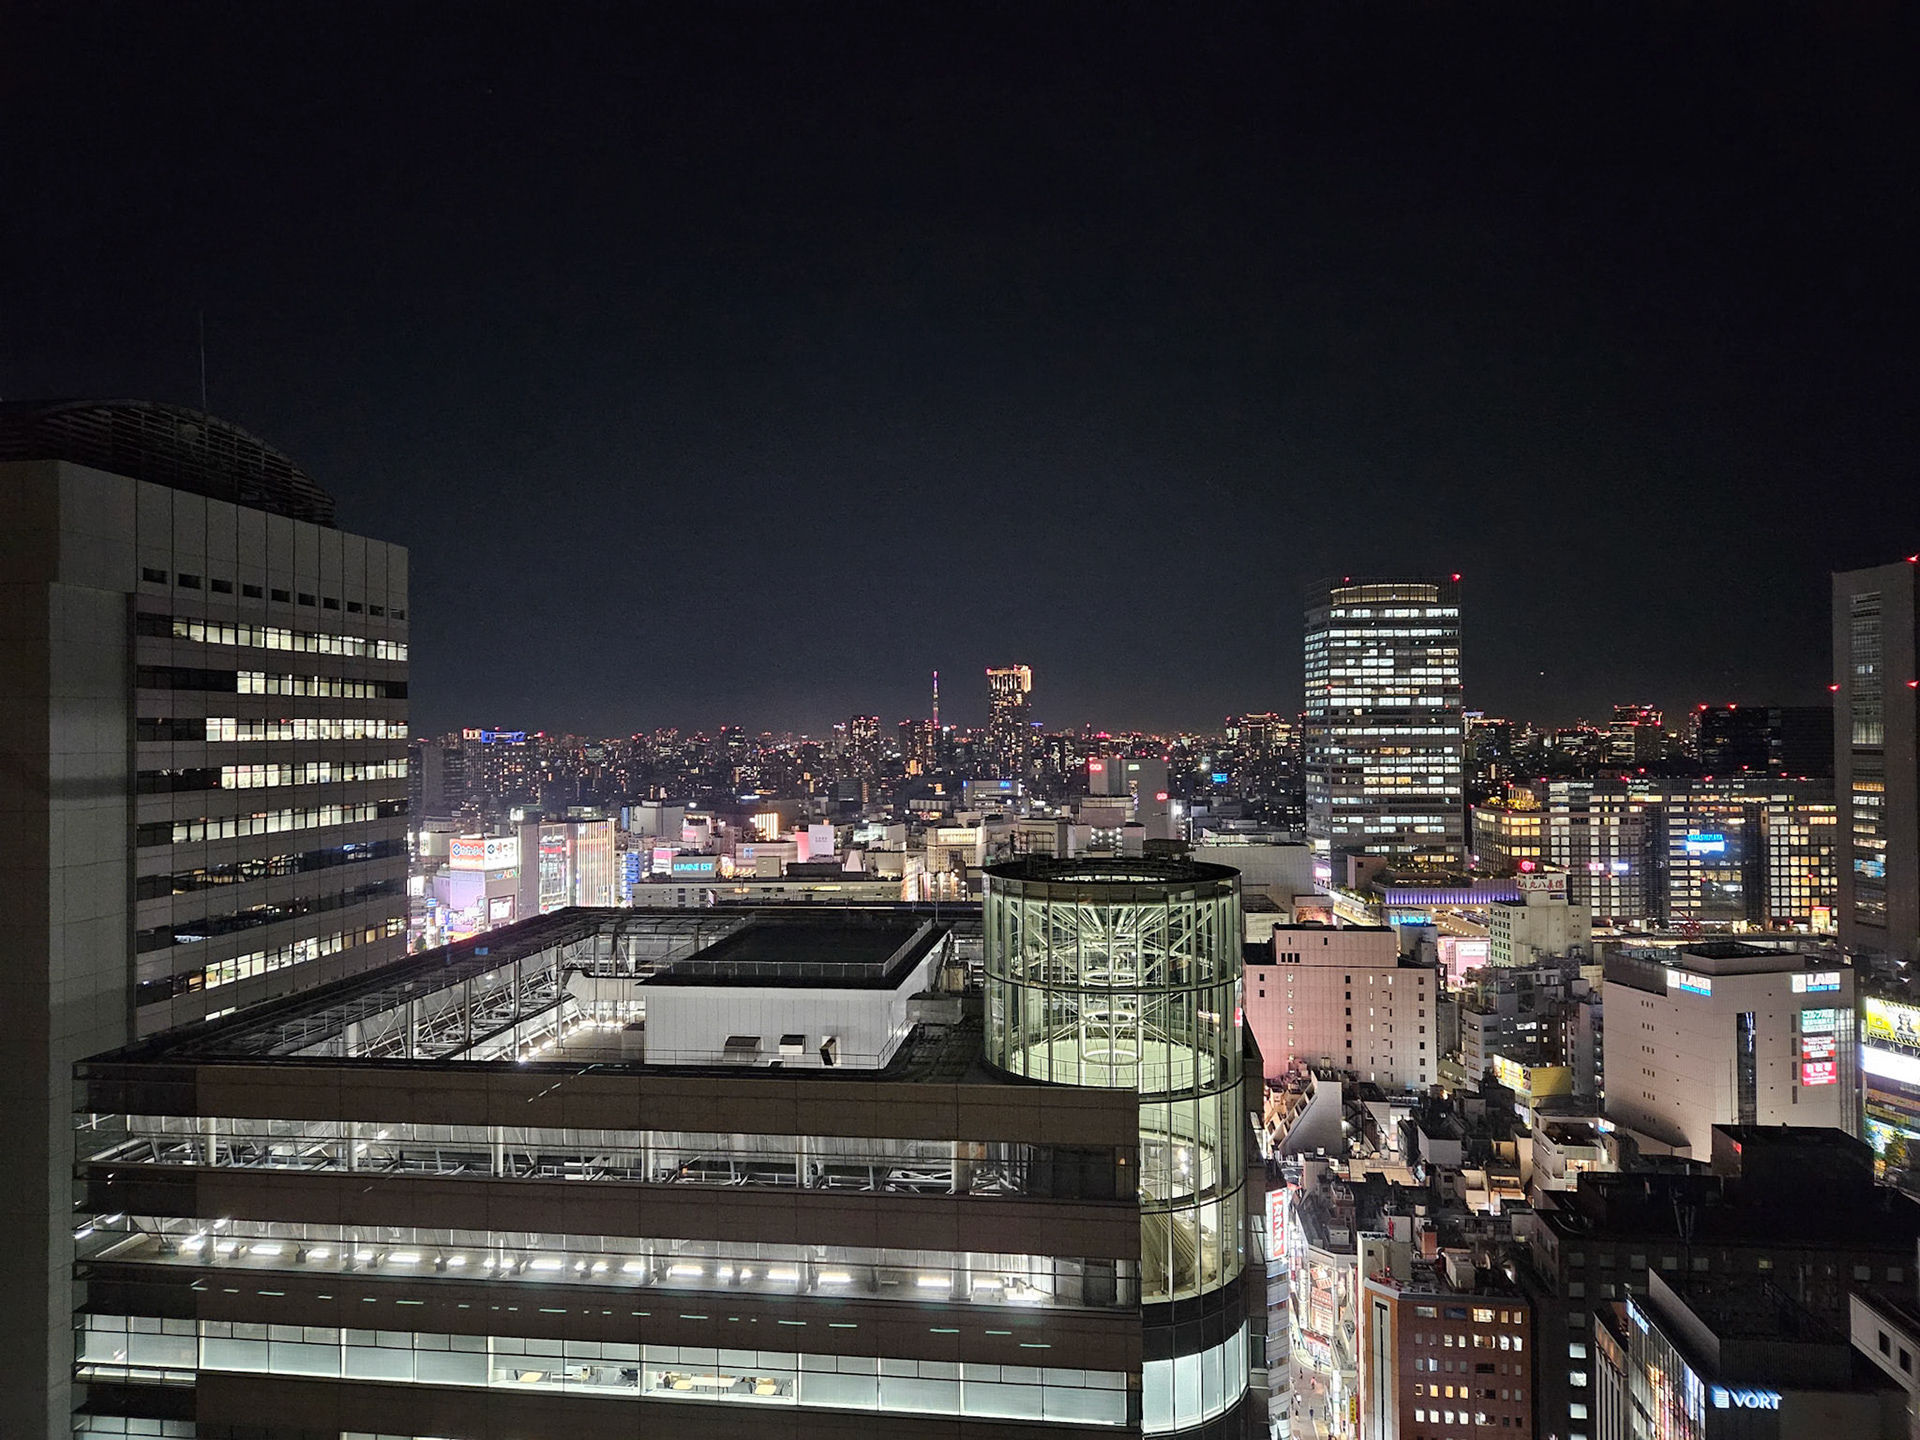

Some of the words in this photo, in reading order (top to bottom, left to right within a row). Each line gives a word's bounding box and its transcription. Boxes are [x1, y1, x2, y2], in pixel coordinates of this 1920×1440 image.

[673, 863, 699, 871] LUMINE
[700, 863, 713, 871] EST
[1729, 1389, 1783, 1410] VORT
